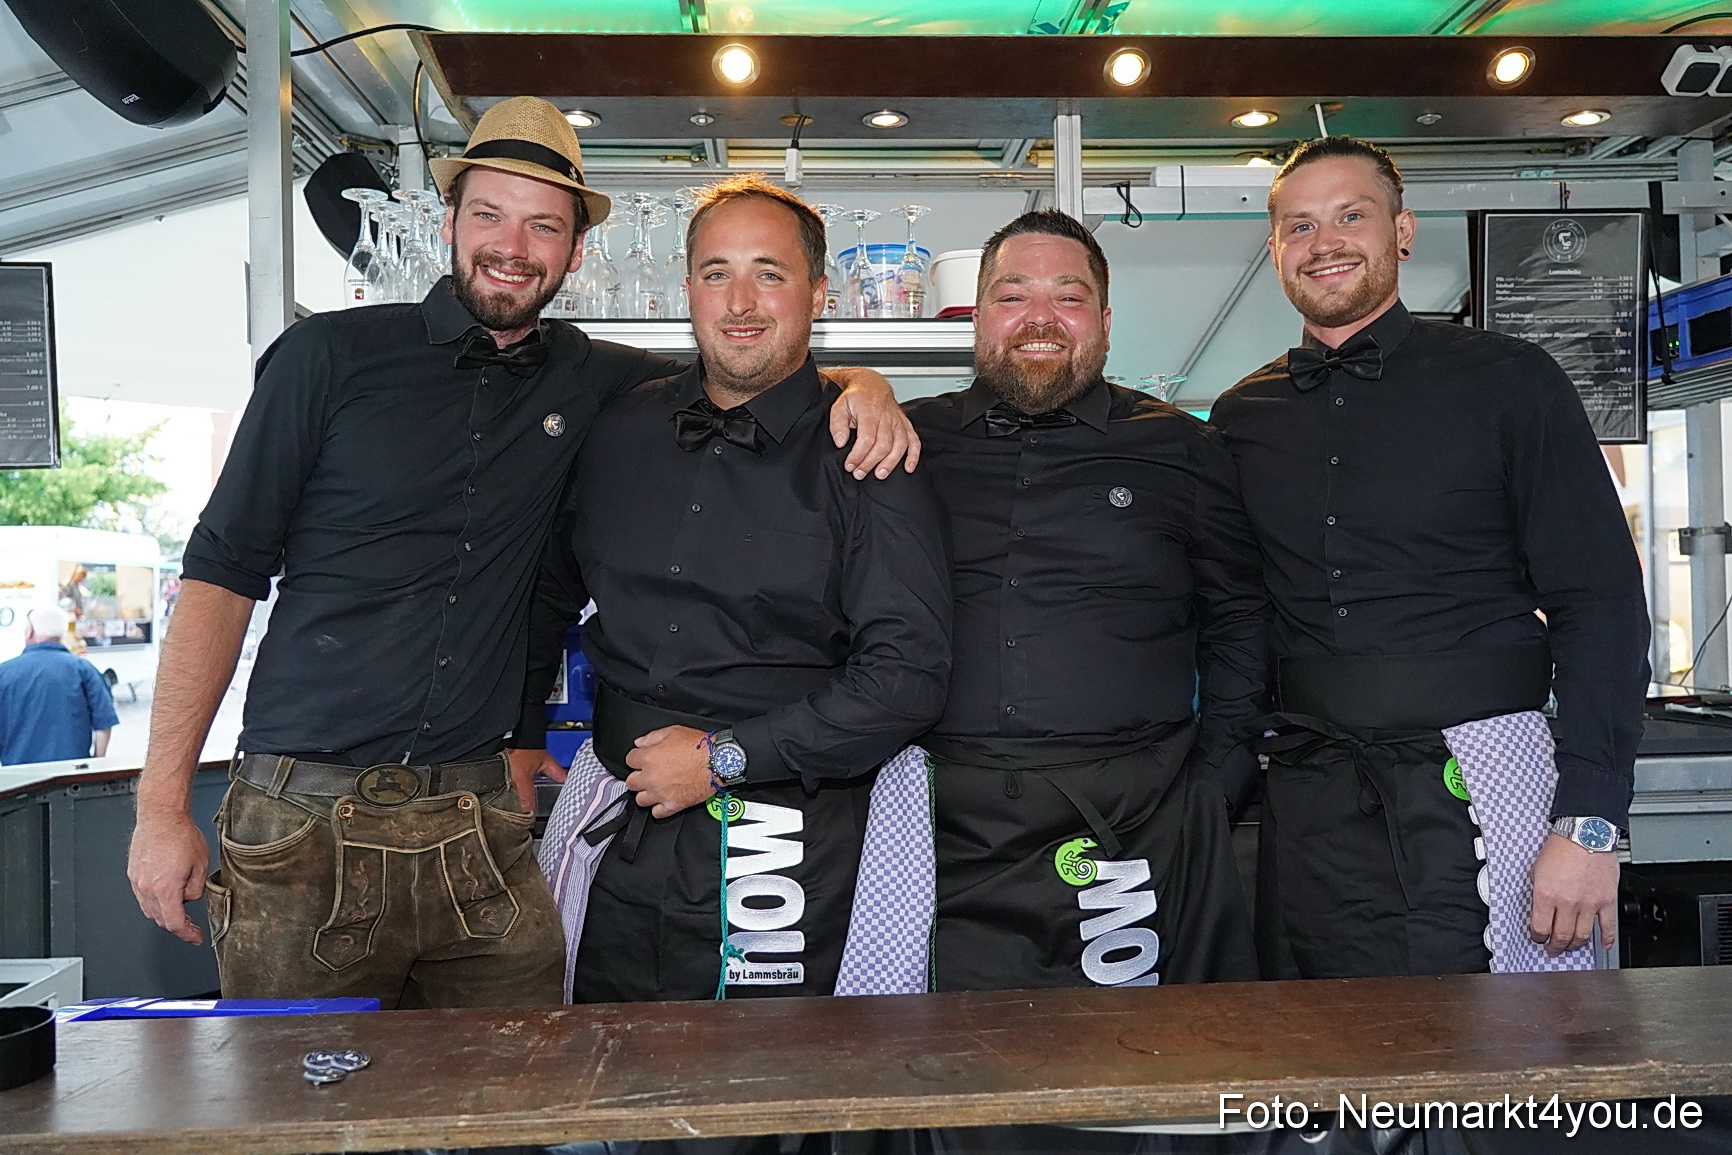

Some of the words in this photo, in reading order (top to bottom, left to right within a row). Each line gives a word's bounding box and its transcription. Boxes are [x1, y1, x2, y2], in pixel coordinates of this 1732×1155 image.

[1077, 858, 1160, 987] ow
[729, 969, 741, 982] by
[743, 967, 799, 980] Lammsbräu
